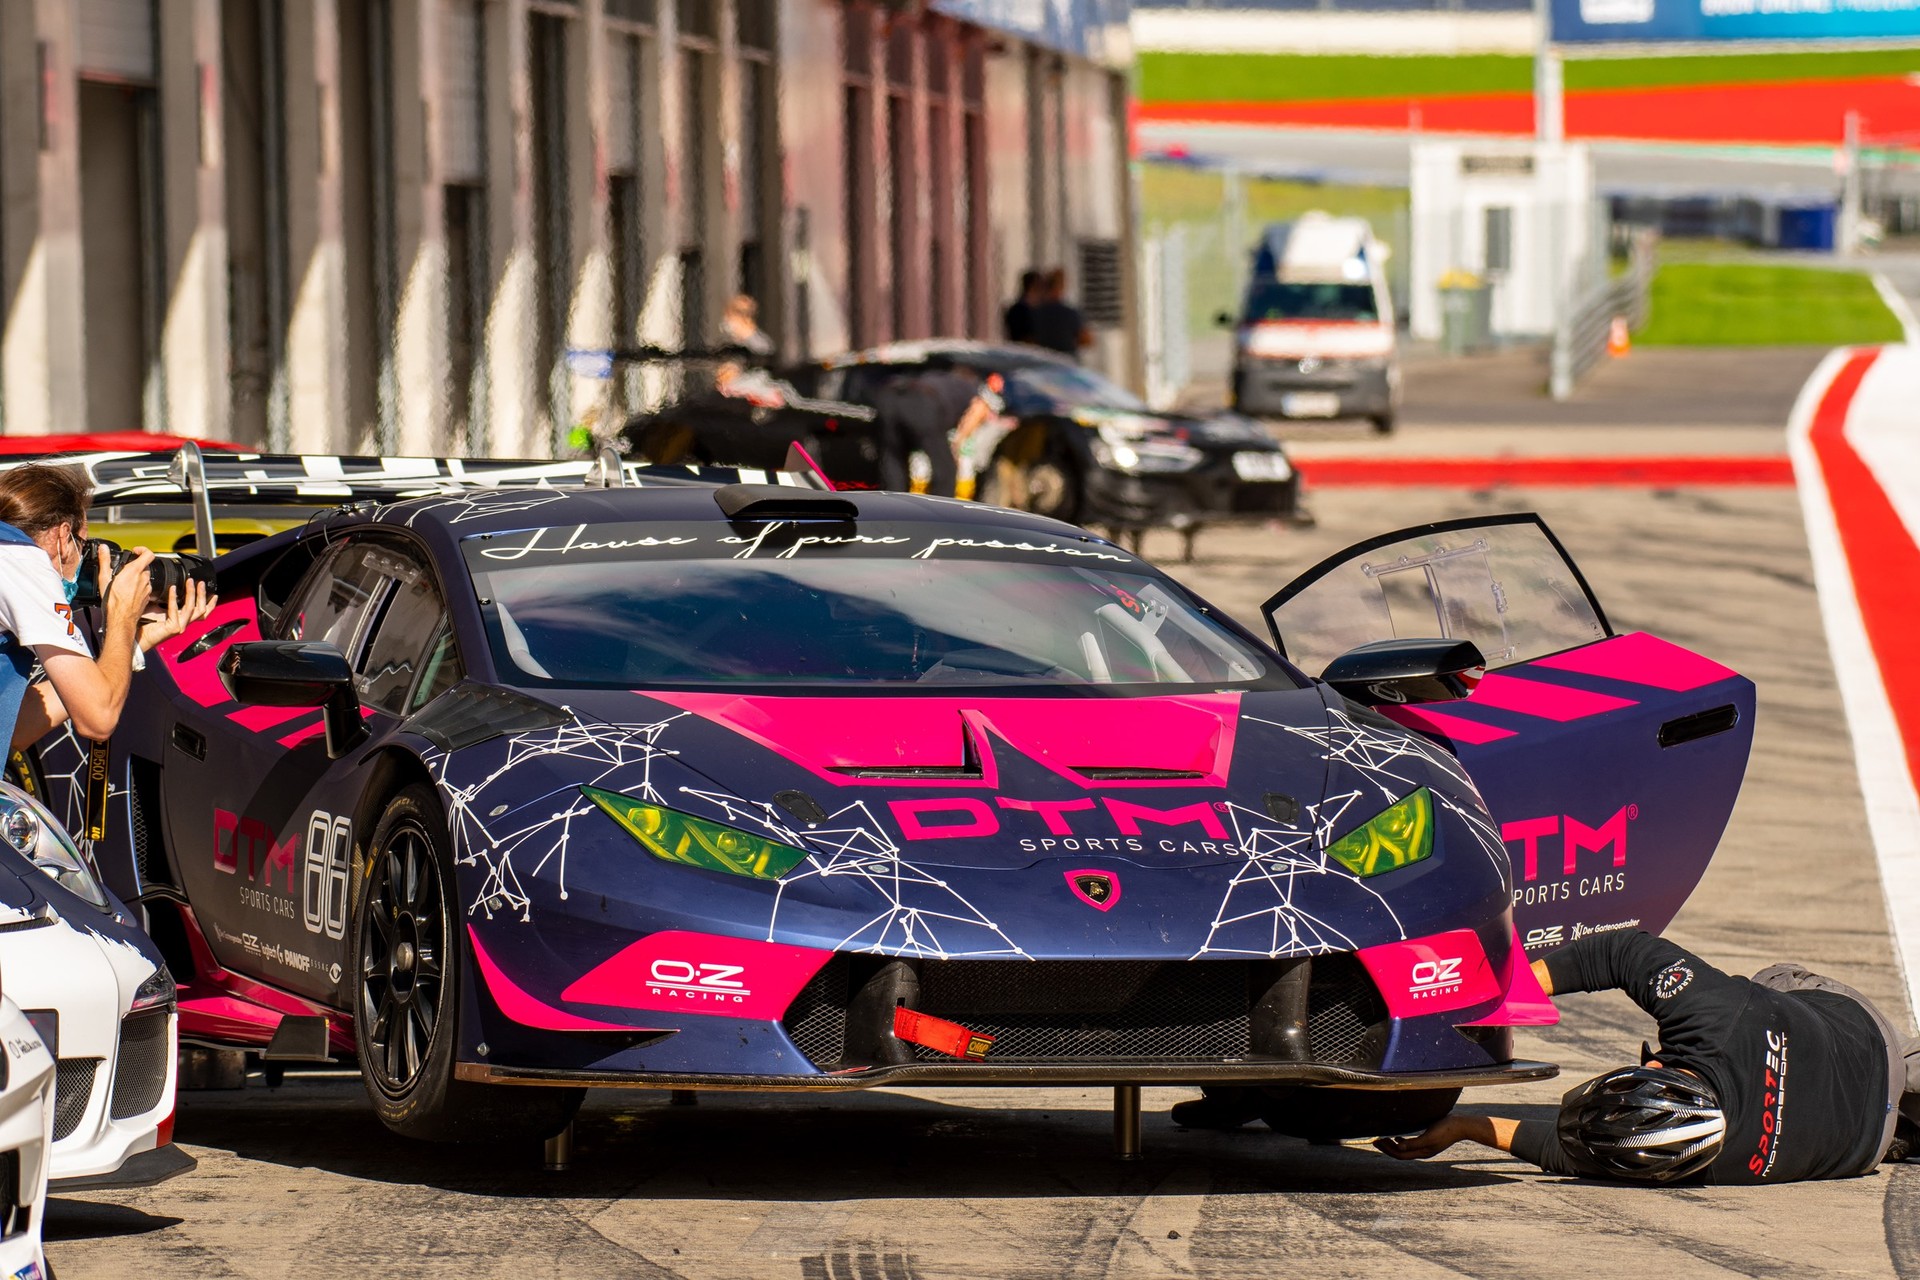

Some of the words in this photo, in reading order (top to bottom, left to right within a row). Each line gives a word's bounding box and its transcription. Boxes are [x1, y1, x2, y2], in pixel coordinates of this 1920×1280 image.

[481, 524, 697, 559] House
[717, 521, 784, 559] of
[776, 534, 910, 559] pure
[911, 537, 1132, 563] passion
[92, 749, 105, 780] D500
[1019, 838, 1143, 852] SPORTS
[1159, 840, 1240, 856] CARS
[1501, 805, 1627, 881] TM
[303, 809, 351, 940] 88
[1512, 881, 1570, 908] PORTS
[1579, 872, 1625, 897] CARS
[239, 886, 271, 912] SPORTS
[273, 896, 295, 919] CARS
[284, 949, 311, 972] PANOFF
[652, 987, 744, 1003] RACING
[1413, 985, 1459, 1000] RACING
[1749, 1029, 1780, 1176] SPORTEC
[1762, 1031, 1788, 1177] MOTORSPORT
